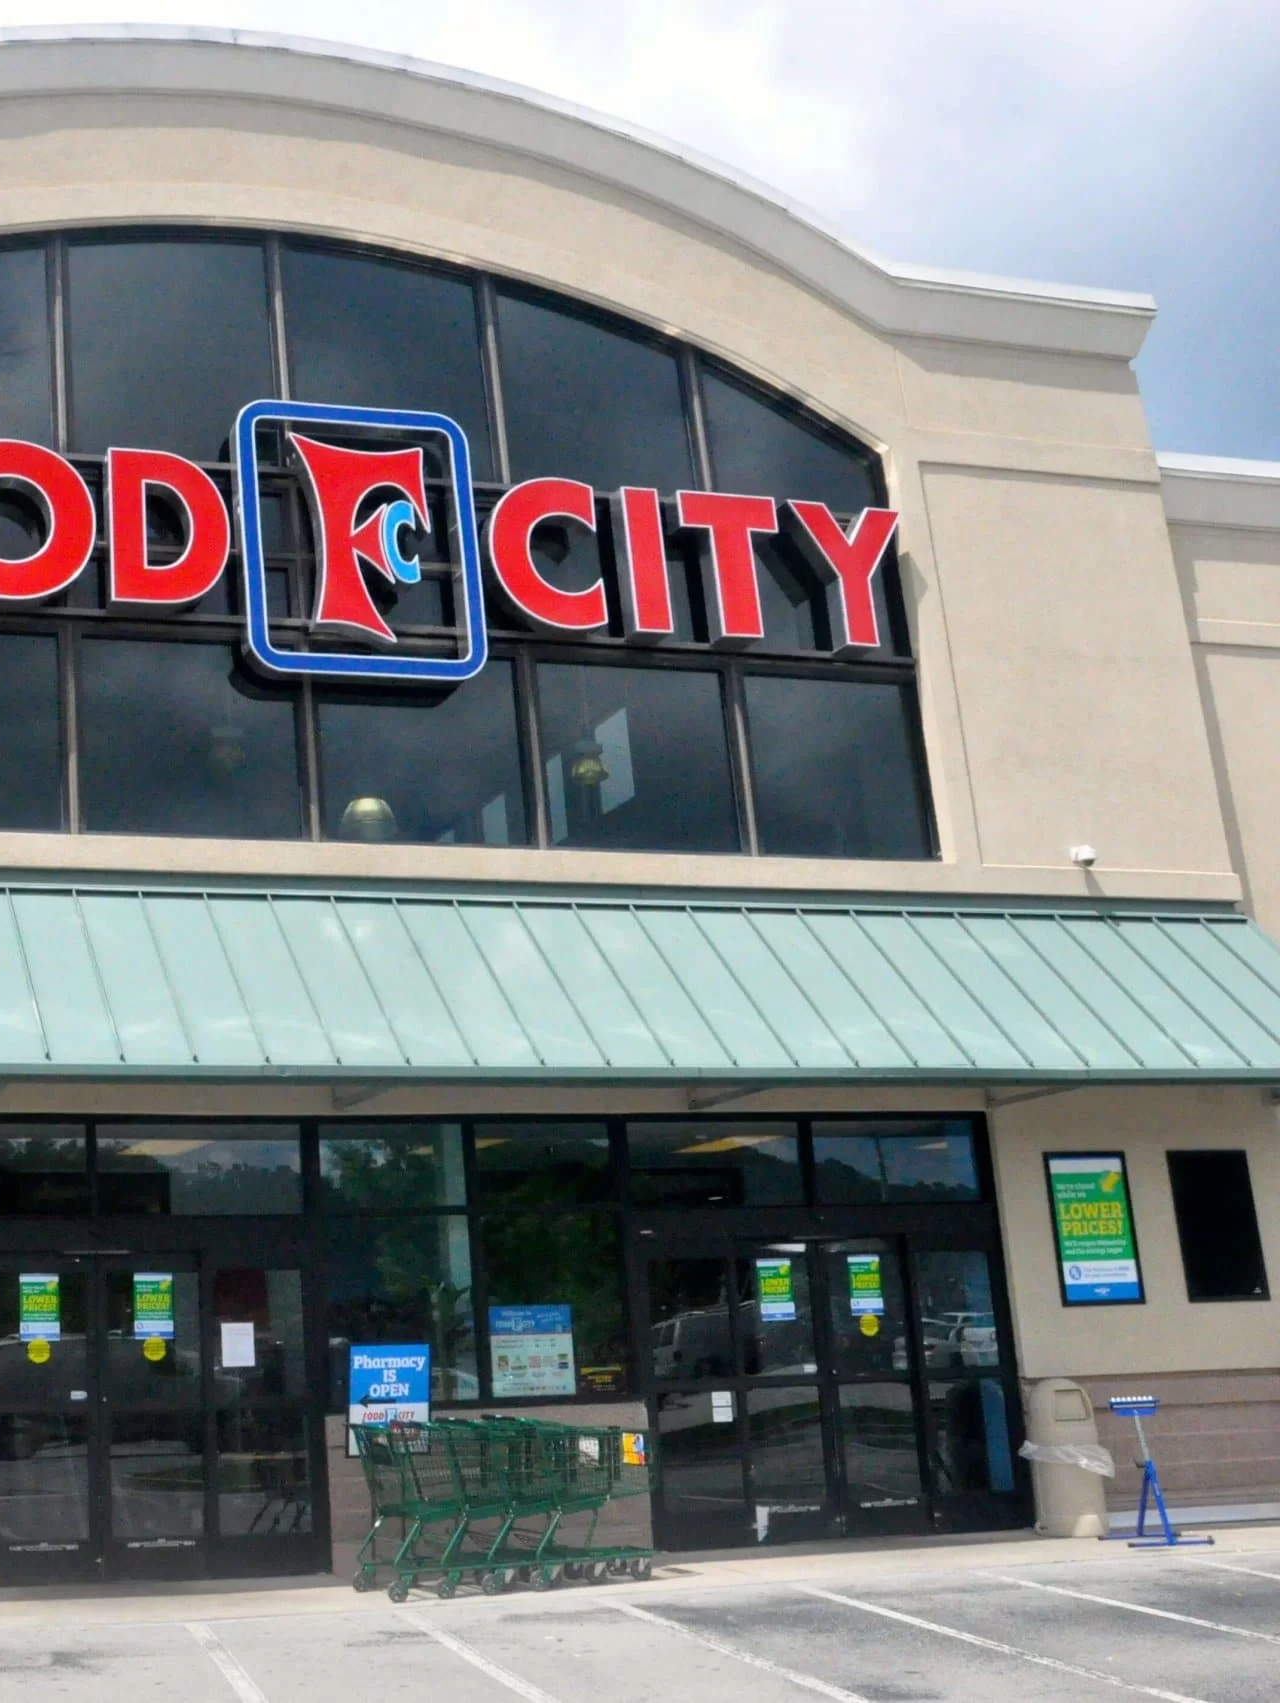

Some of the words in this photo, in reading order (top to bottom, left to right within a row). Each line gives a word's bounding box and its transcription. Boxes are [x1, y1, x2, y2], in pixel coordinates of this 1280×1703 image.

[488, 476, 900, 647] CITY
[1059, 1202, 1124, 1219] LOWER
[1061, 1220, 1123, 1236] PRICES!
[352, 1354, 427, 1372] Pharmacy
[382, 1369, 397, 1383] IS
[368, 1383, 410, 1398] OPEN
